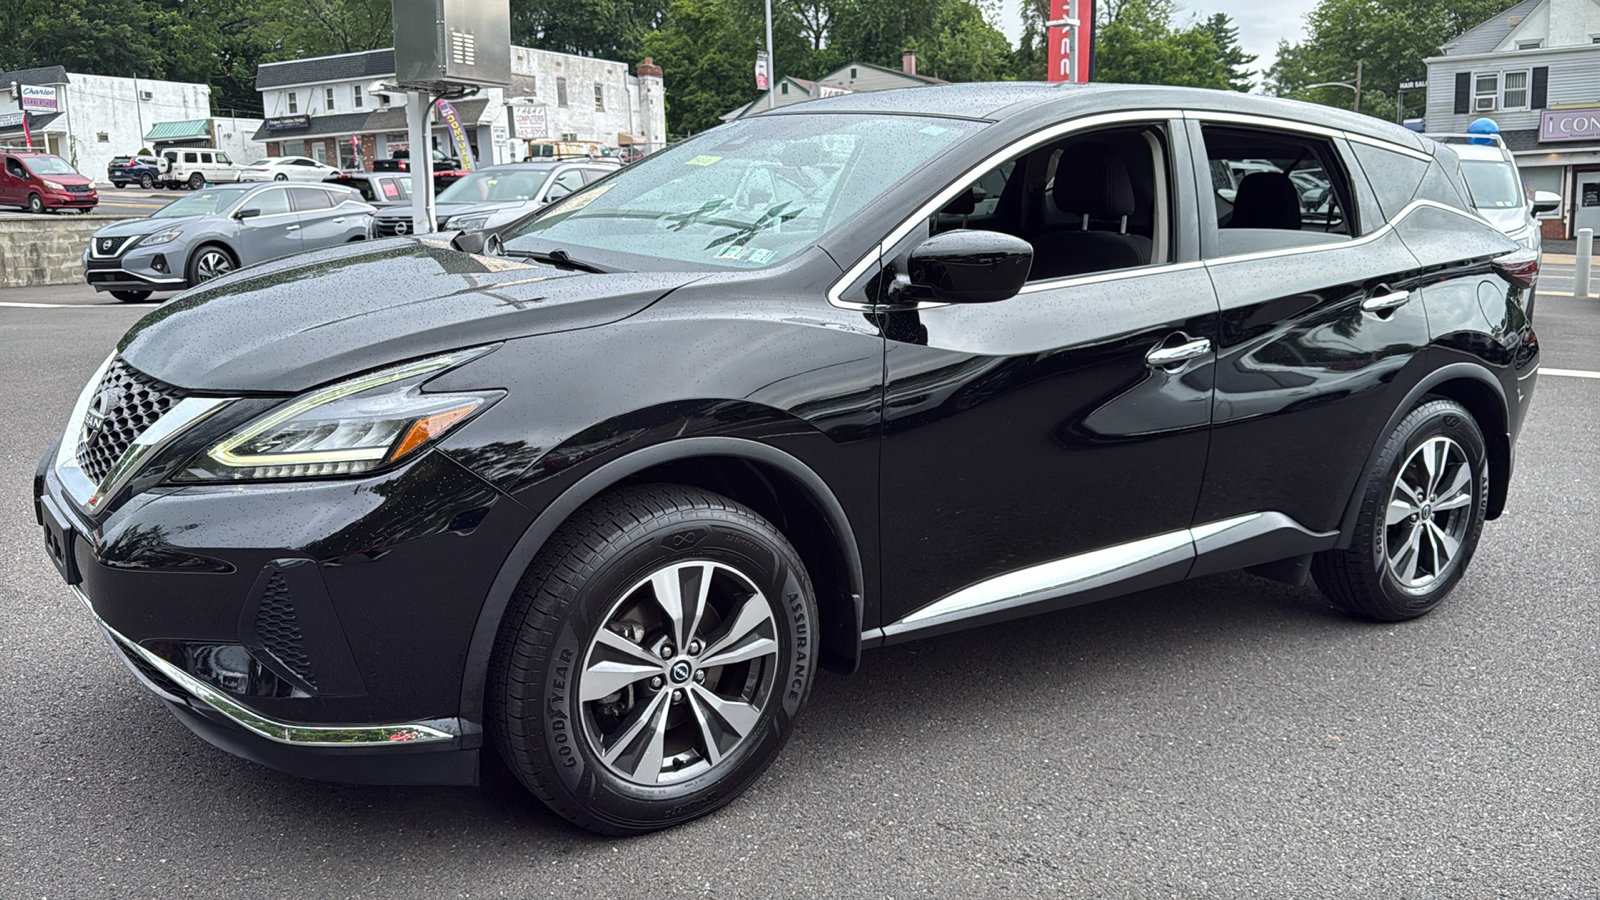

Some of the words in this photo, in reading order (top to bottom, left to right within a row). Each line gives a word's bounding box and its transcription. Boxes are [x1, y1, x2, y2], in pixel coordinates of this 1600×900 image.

[1399, 81, 1414, 89] HAIR
[23, 87, 55, 96] Charles
[515, 115, 544, 123] COMPUTERS
[787, 592, 808, 702] ASSURANCE
[546, 647, 577, 768] GOODYEAR
